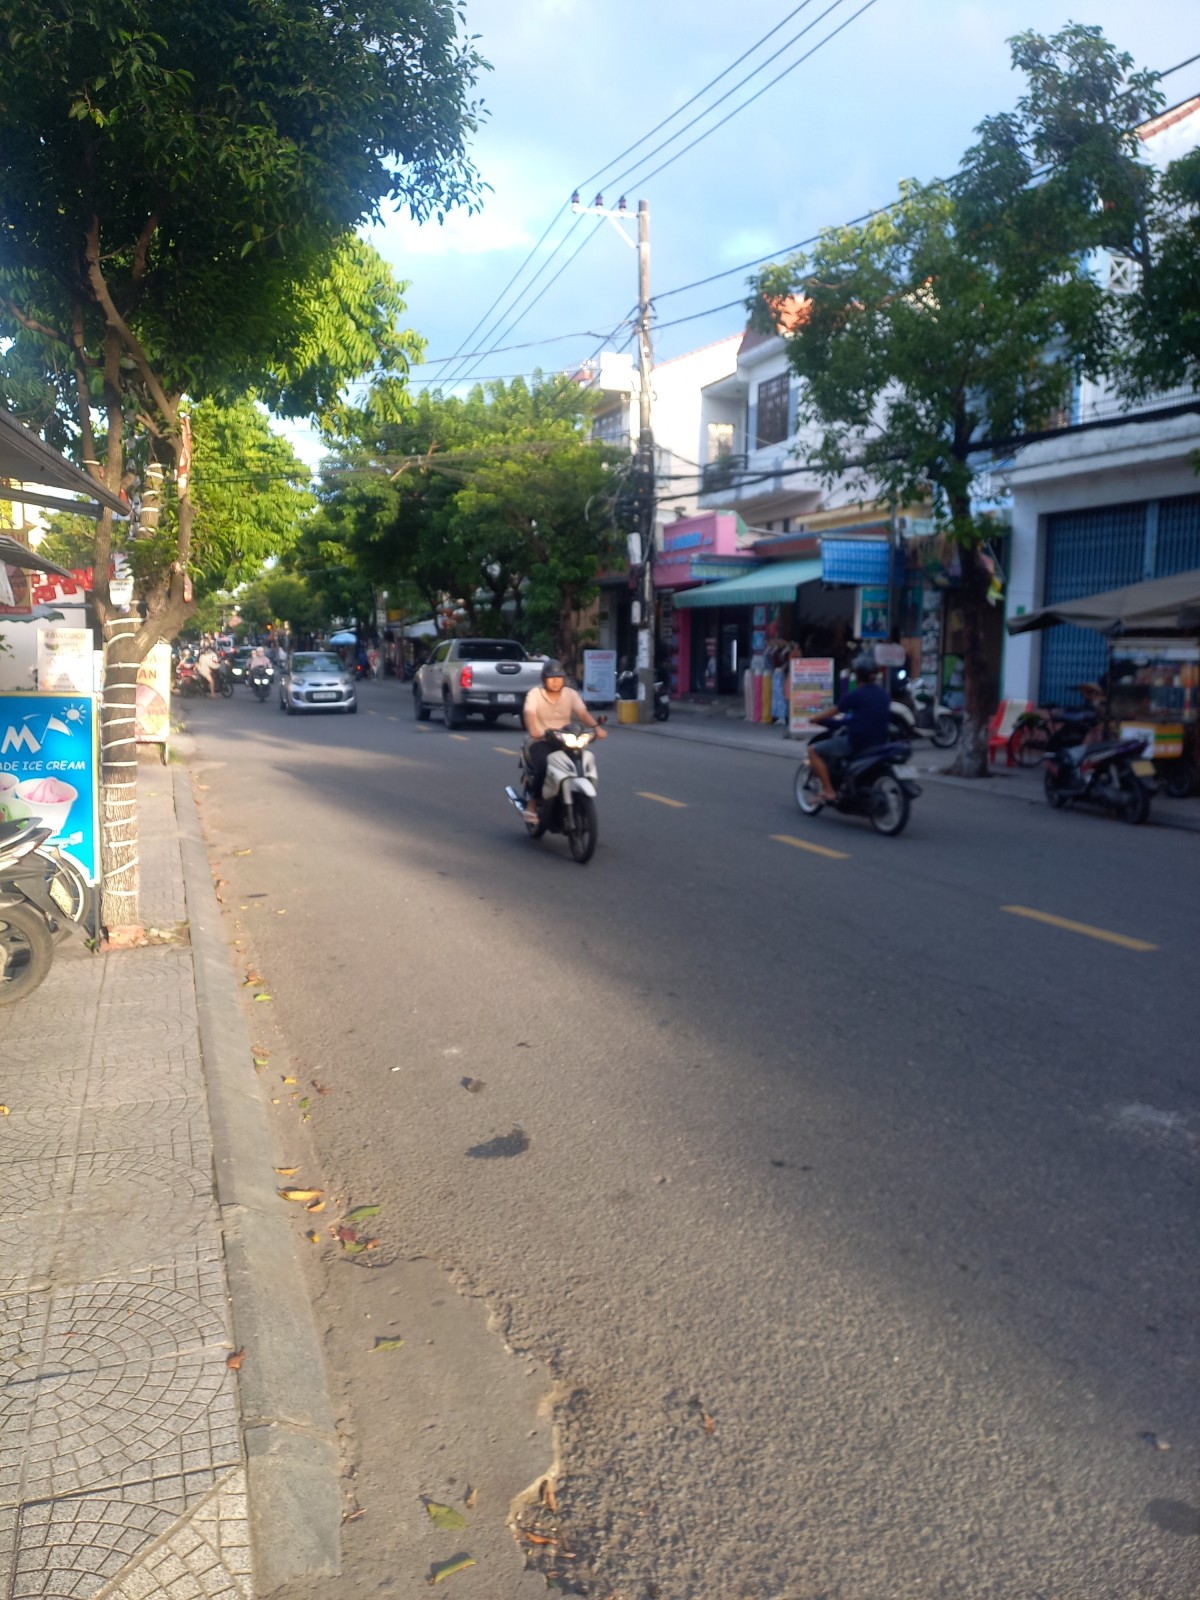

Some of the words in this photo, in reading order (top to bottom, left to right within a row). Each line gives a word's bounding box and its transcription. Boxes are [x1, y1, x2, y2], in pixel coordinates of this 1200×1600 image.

[0, 761, 19, 771] DE
[22, 761, 43, 771] ICE
[45, 760, 86, 771] CREAM
